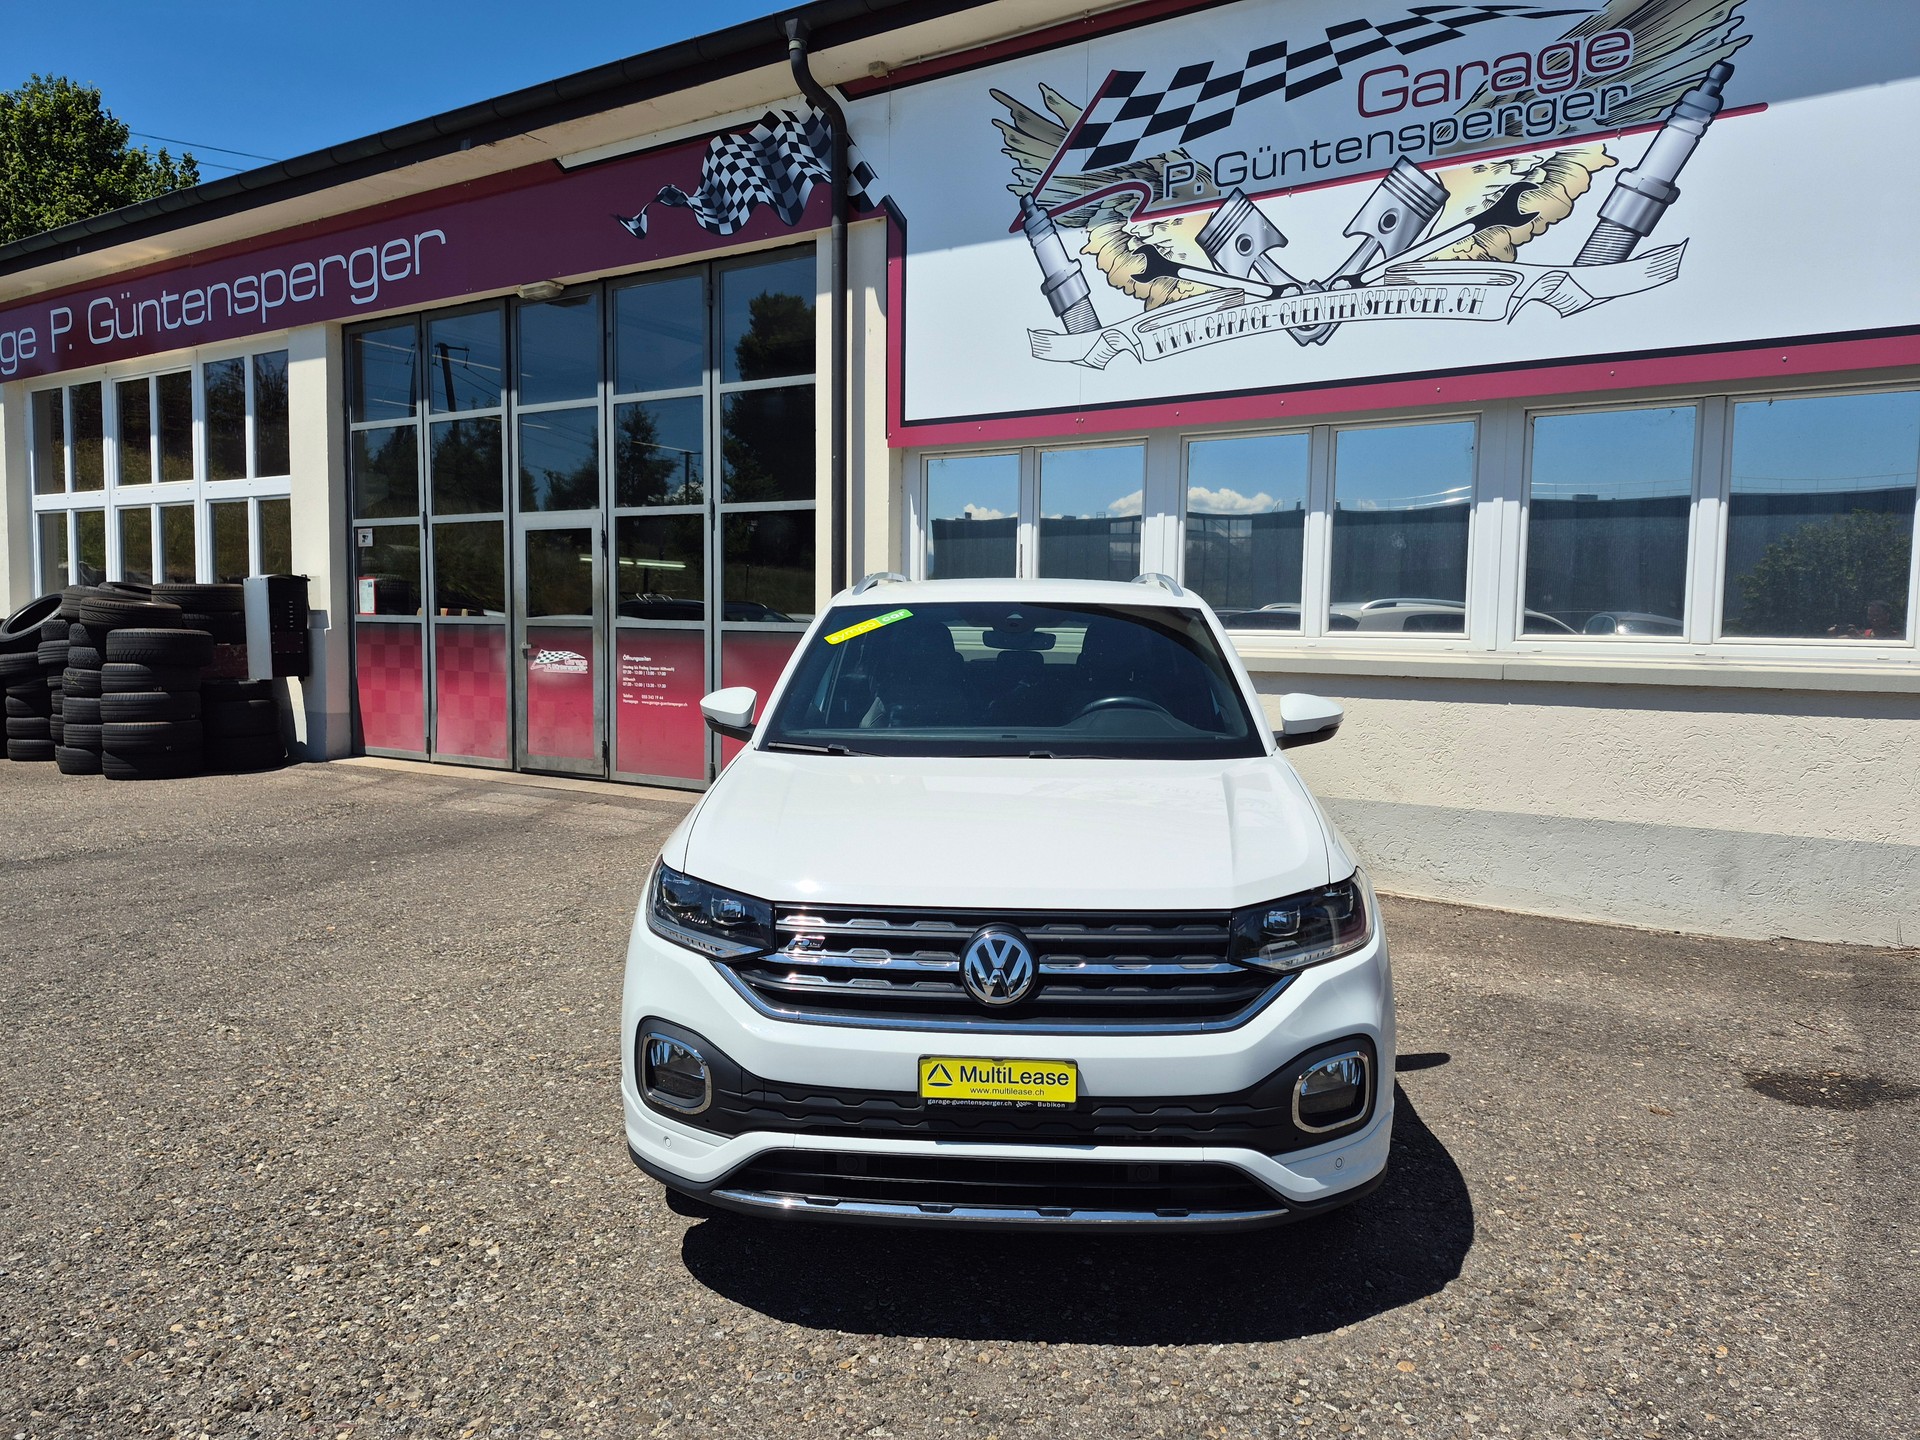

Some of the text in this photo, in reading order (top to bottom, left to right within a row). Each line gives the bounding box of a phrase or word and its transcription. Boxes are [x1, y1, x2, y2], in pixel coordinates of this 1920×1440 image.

[1357, 31, 1632, 119] Garage
[1213, 84, 1629, 187] Güntensperger
[50, 306, 74, 352] P.
[88, 228, 447, 345] Güntensperger
[830, 610, 905, 643] sympa car
[959, 1065, 1070, 1086] MultiLease
[970, 1086, 1045, 1096] www.multilease.ch
[927, 1098, 1013, 1107] garage-guentensperger.ch
